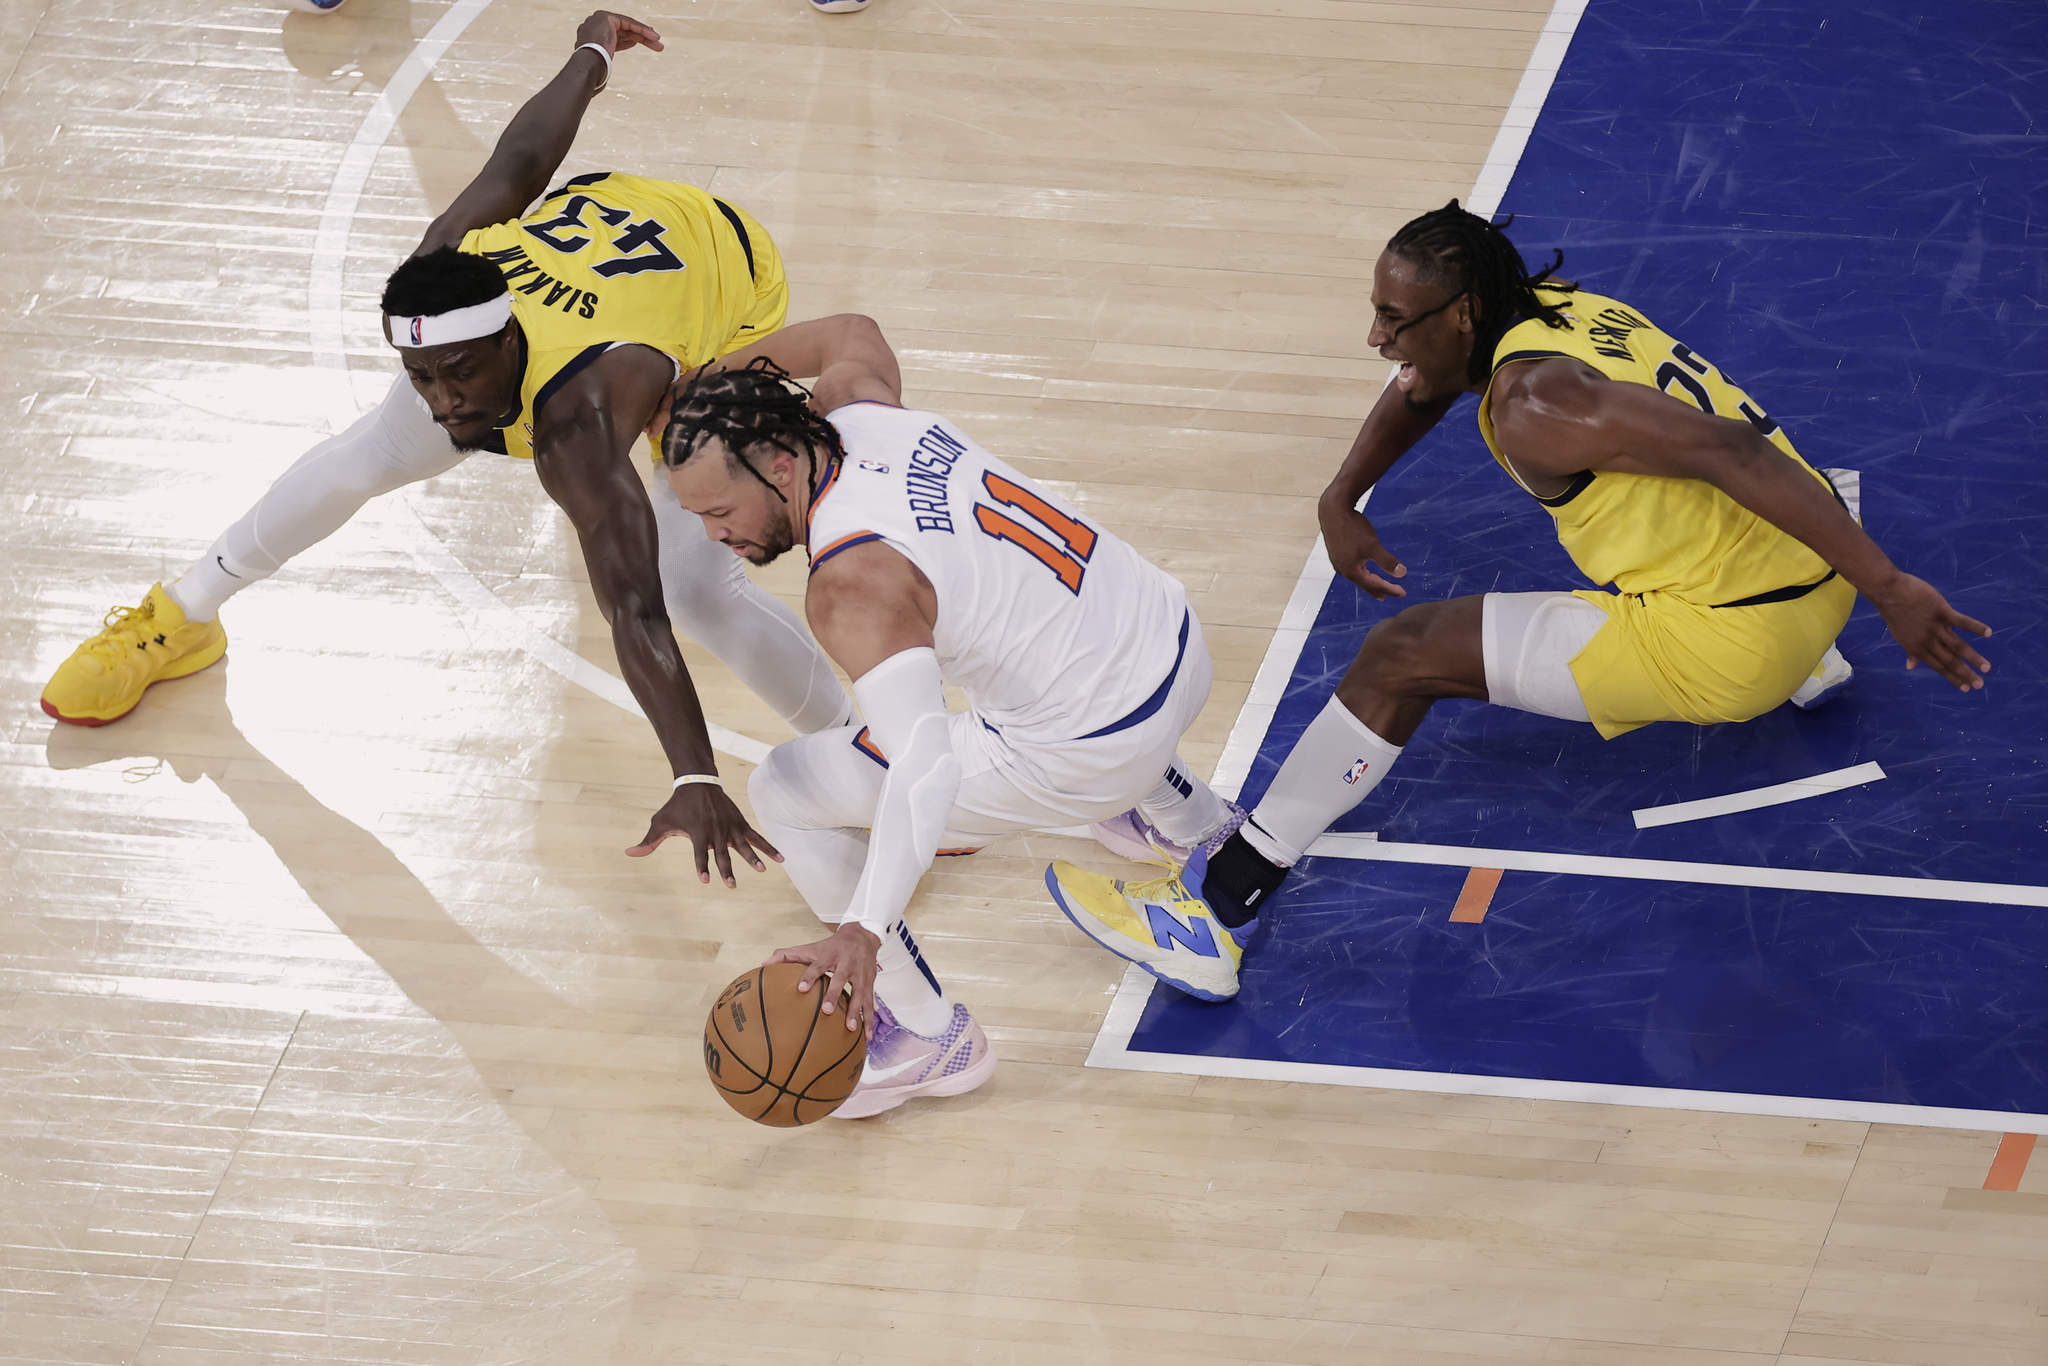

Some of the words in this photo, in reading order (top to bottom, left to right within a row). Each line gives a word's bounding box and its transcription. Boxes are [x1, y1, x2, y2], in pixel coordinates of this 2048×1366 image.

[521, 194, 688, 280] 43
[481, 244, 599, 320] SIAKAM
[906, 424, 968, 534] BRUNSON
[972, 468, 1098, 597] 11
[1144, 904, 1220, 959] N
